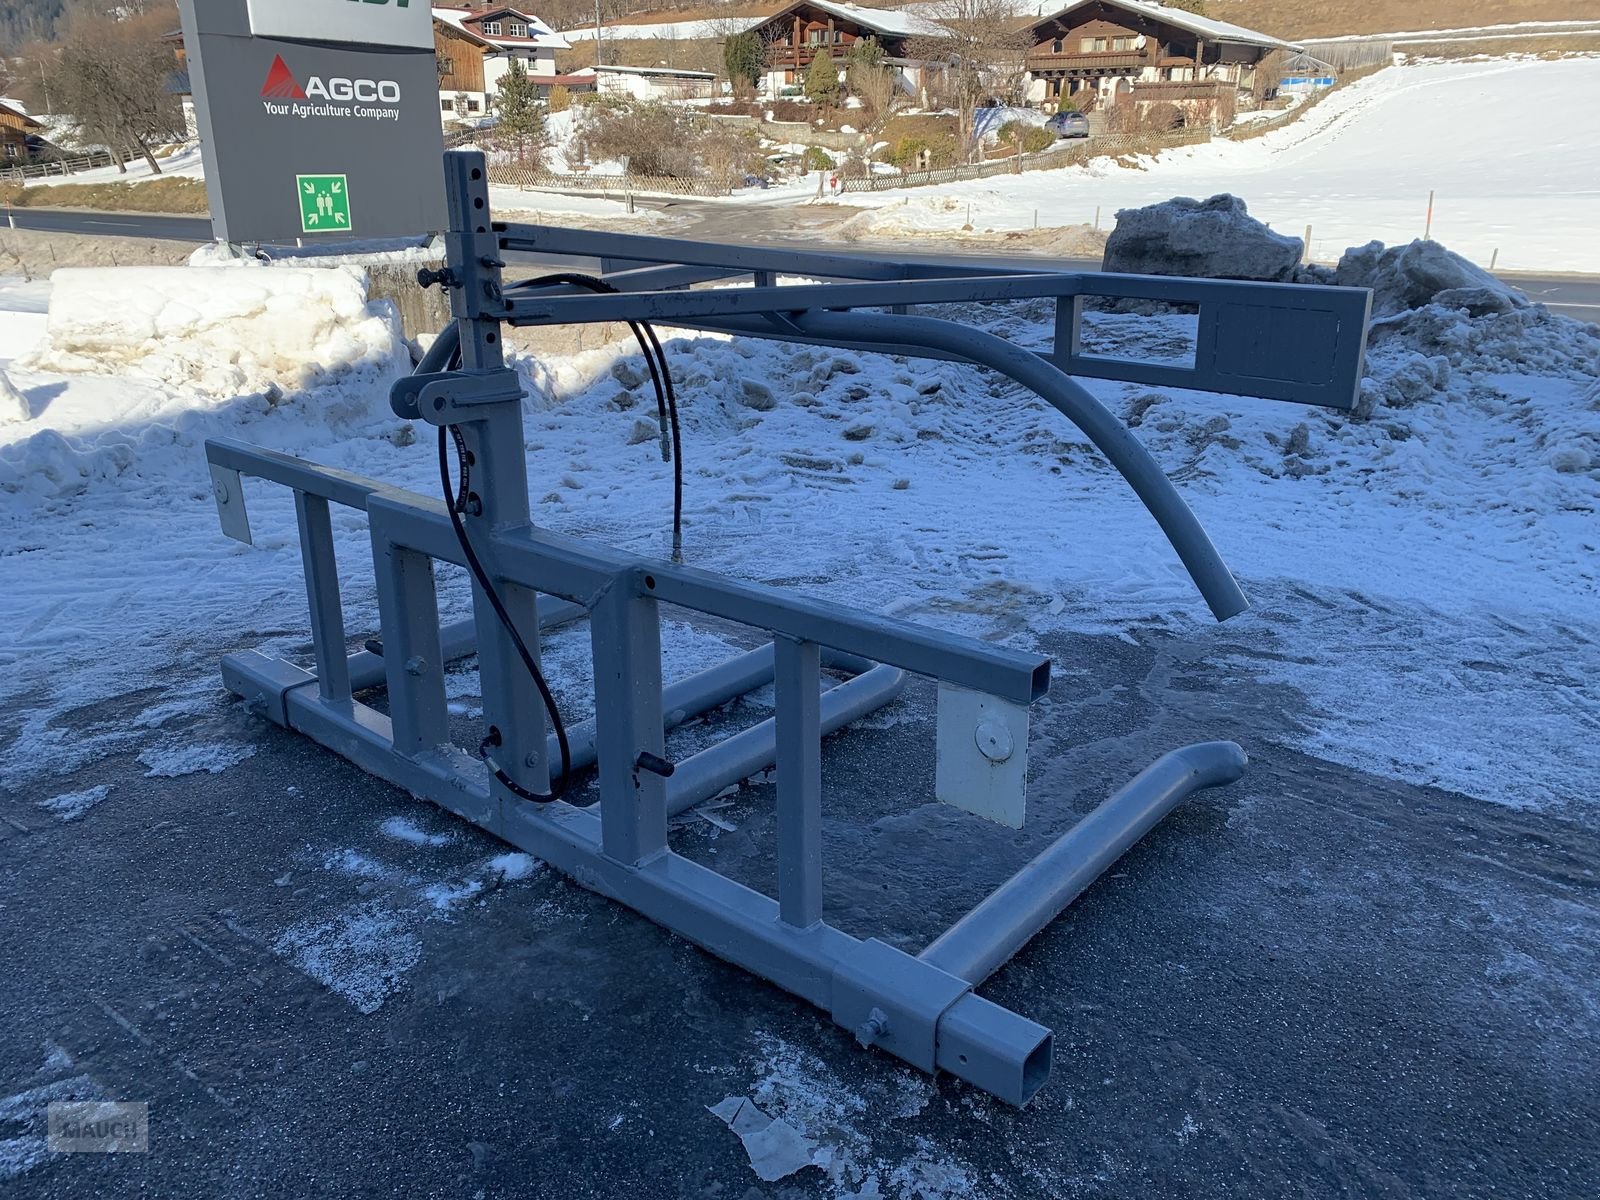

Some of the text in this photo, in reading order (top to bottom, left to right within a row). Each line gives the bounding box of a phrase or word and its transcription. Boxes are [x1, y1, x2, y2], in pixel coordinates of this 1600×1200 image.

[305, 76, 400, 103] AGCO
[263, 101, 400, 121] Your Agriculture Company
